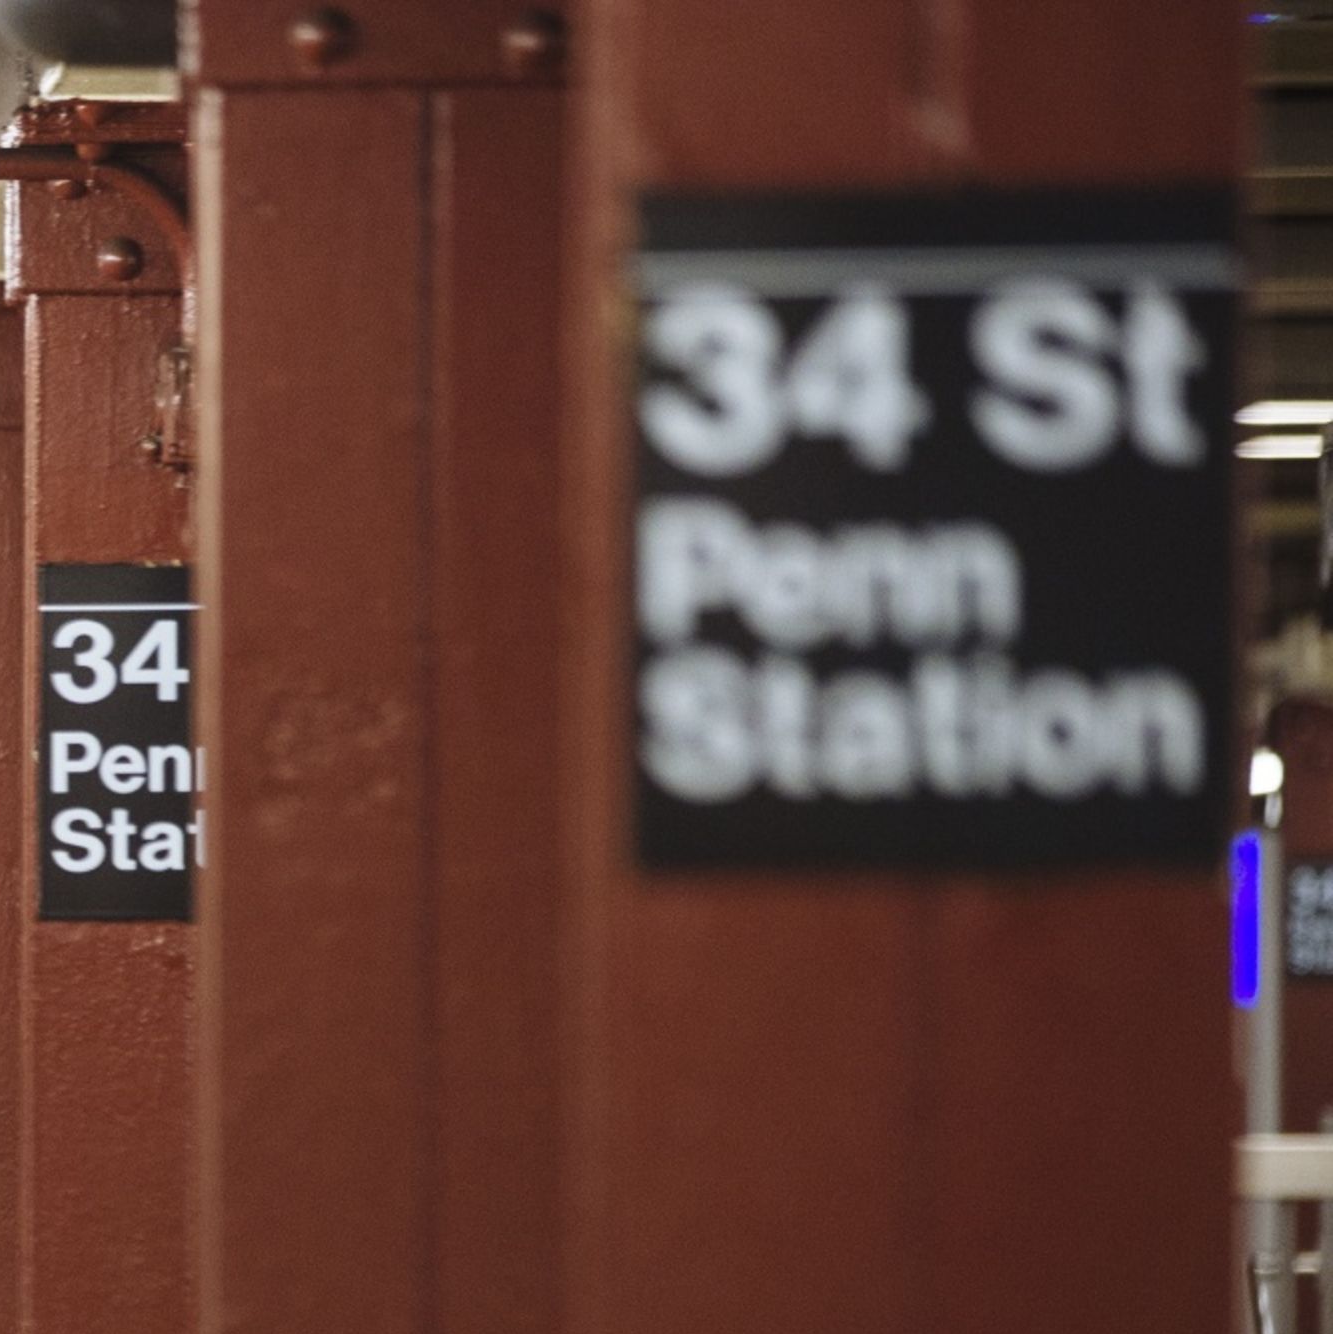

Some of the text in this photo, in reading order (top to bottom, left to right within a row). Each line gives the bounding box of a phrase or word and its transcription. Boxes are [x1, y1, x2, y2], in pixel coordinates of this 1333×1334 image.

[638, 277, 1206, 476] 34 St
[640, 498, 1022, 650] Penn
[50, 619, 190, 704] 34
[640, 643, 1204, 800] Station
[49, 731, 206, 794] Pen
